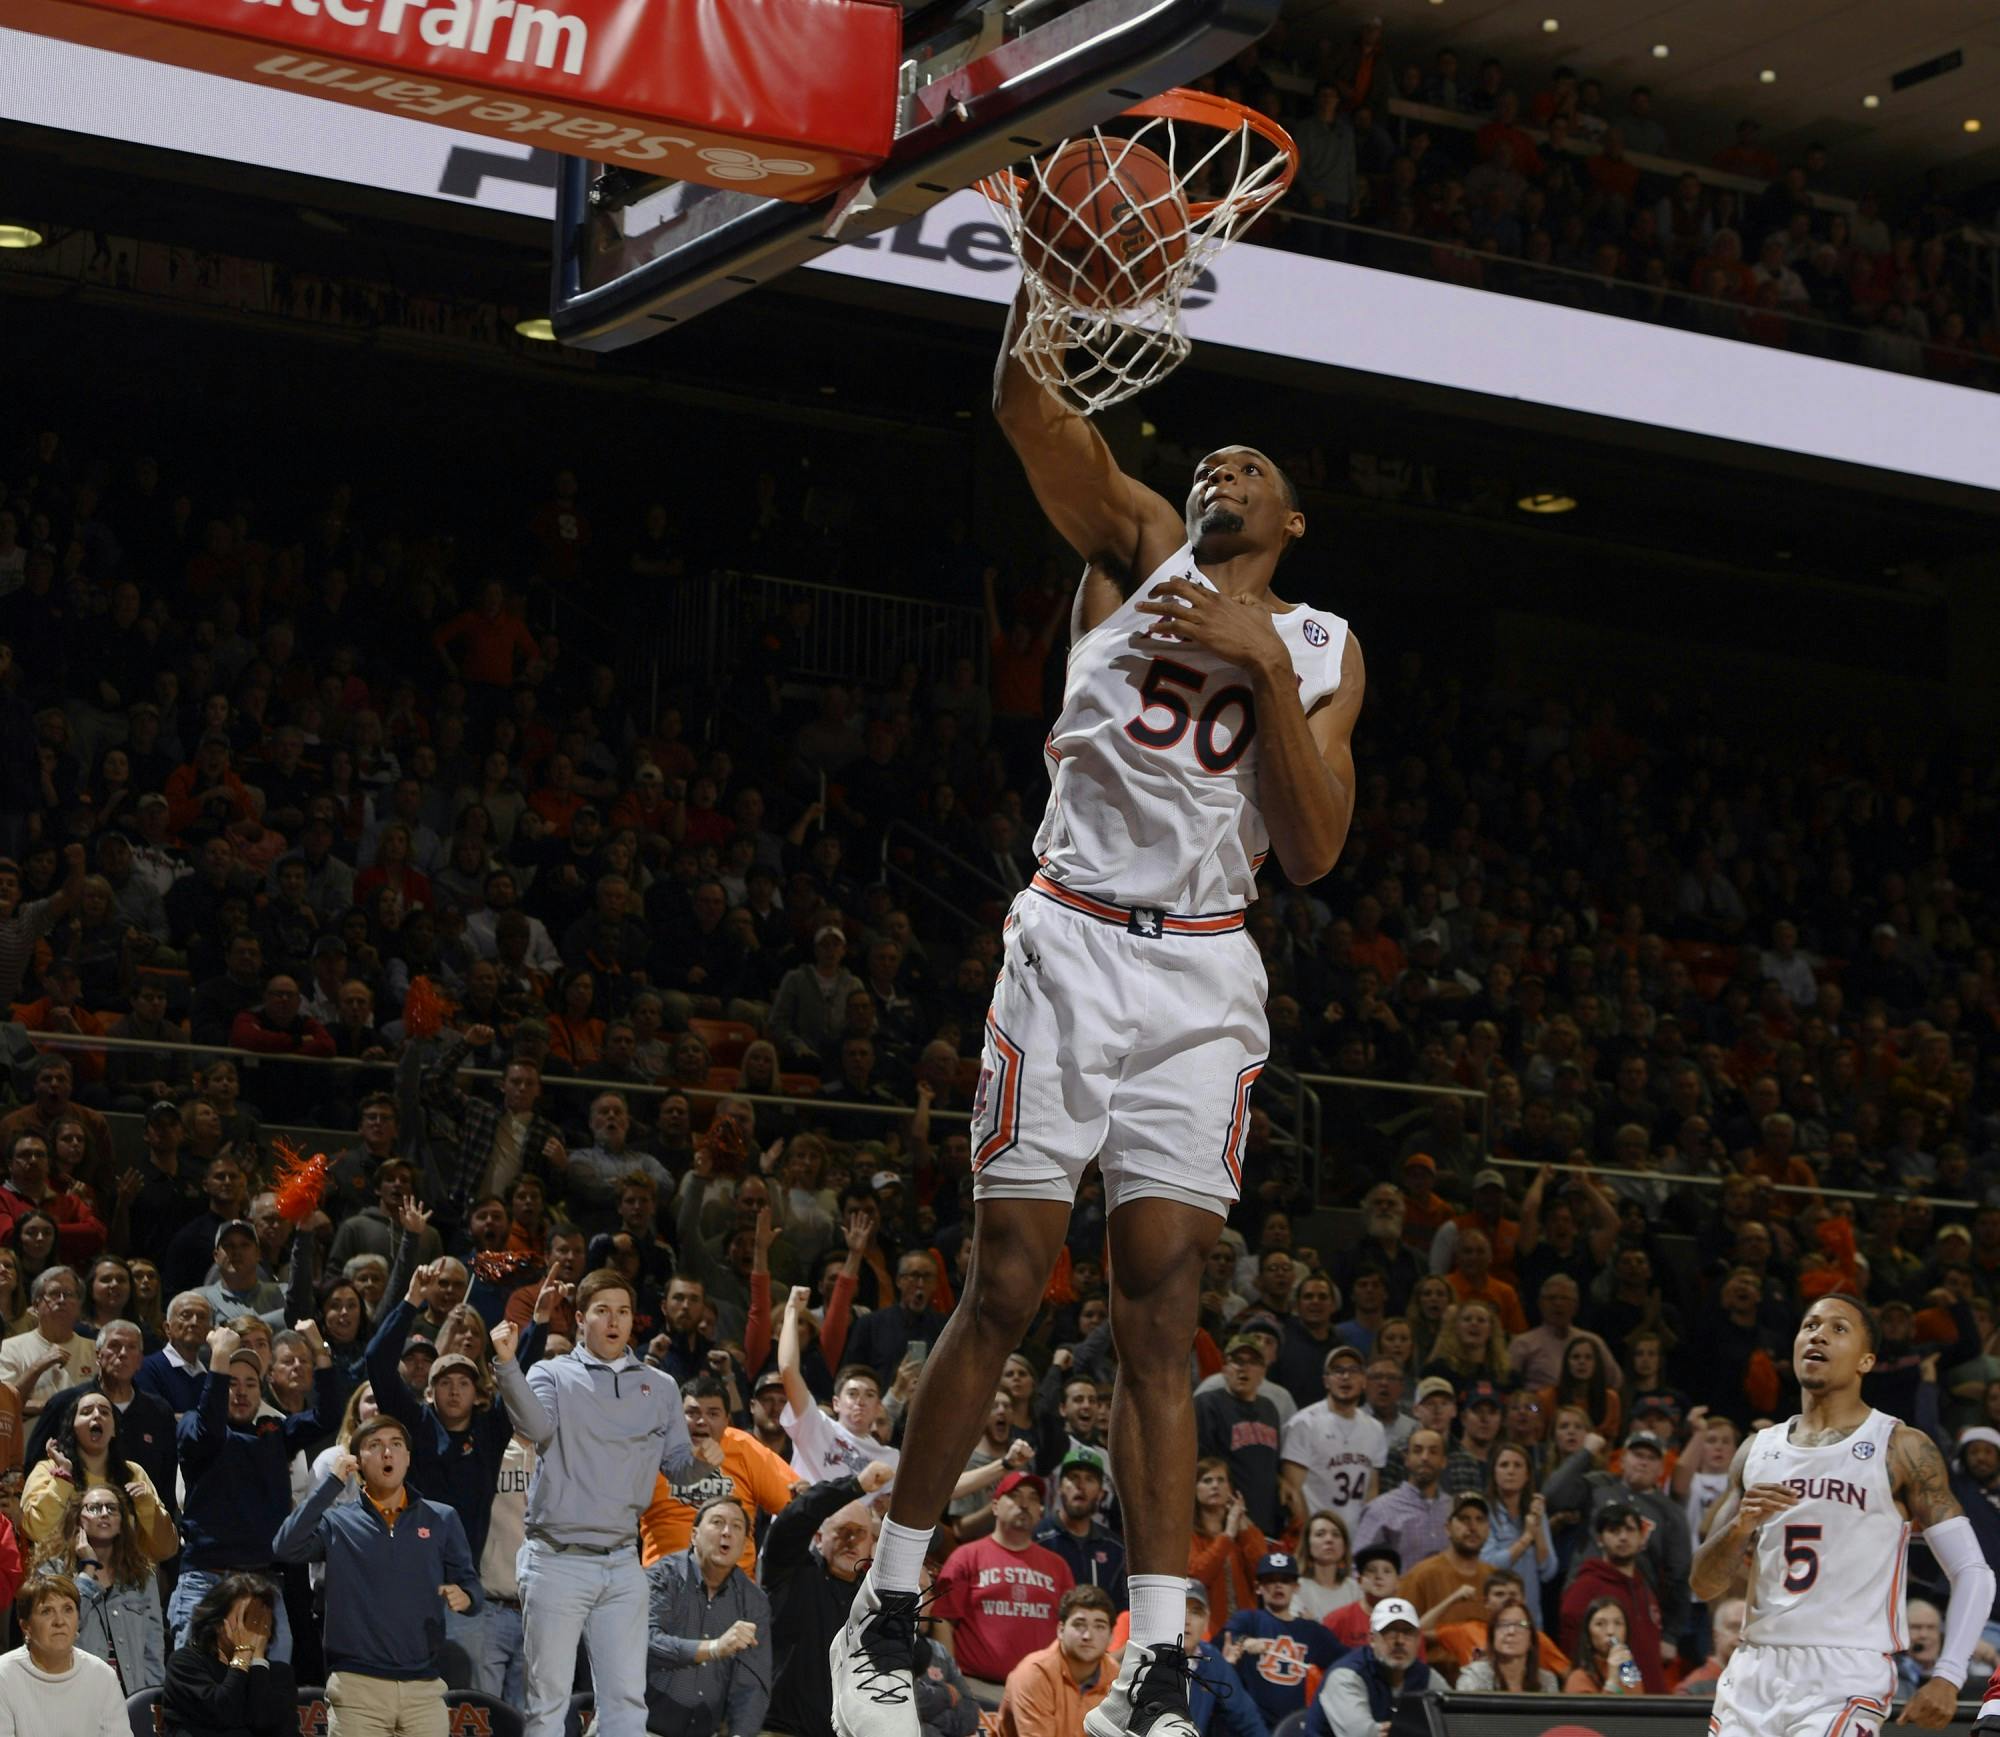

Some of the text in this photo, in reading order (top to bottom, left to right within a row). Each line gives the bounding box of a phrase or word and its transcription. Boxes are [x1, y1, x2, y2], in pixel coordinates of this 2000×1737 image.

[1124, 655, 1257, 775] 50
[1333, 1471, 1366, 1506] 34
[1782, 1478, 1867, 1511] BURN
[1784, 1525, 1823, 1594] 5
[978, 1566, 1056, 1592] NC STATE
[981, 1599, 1052, 1620] WOLFPACK
